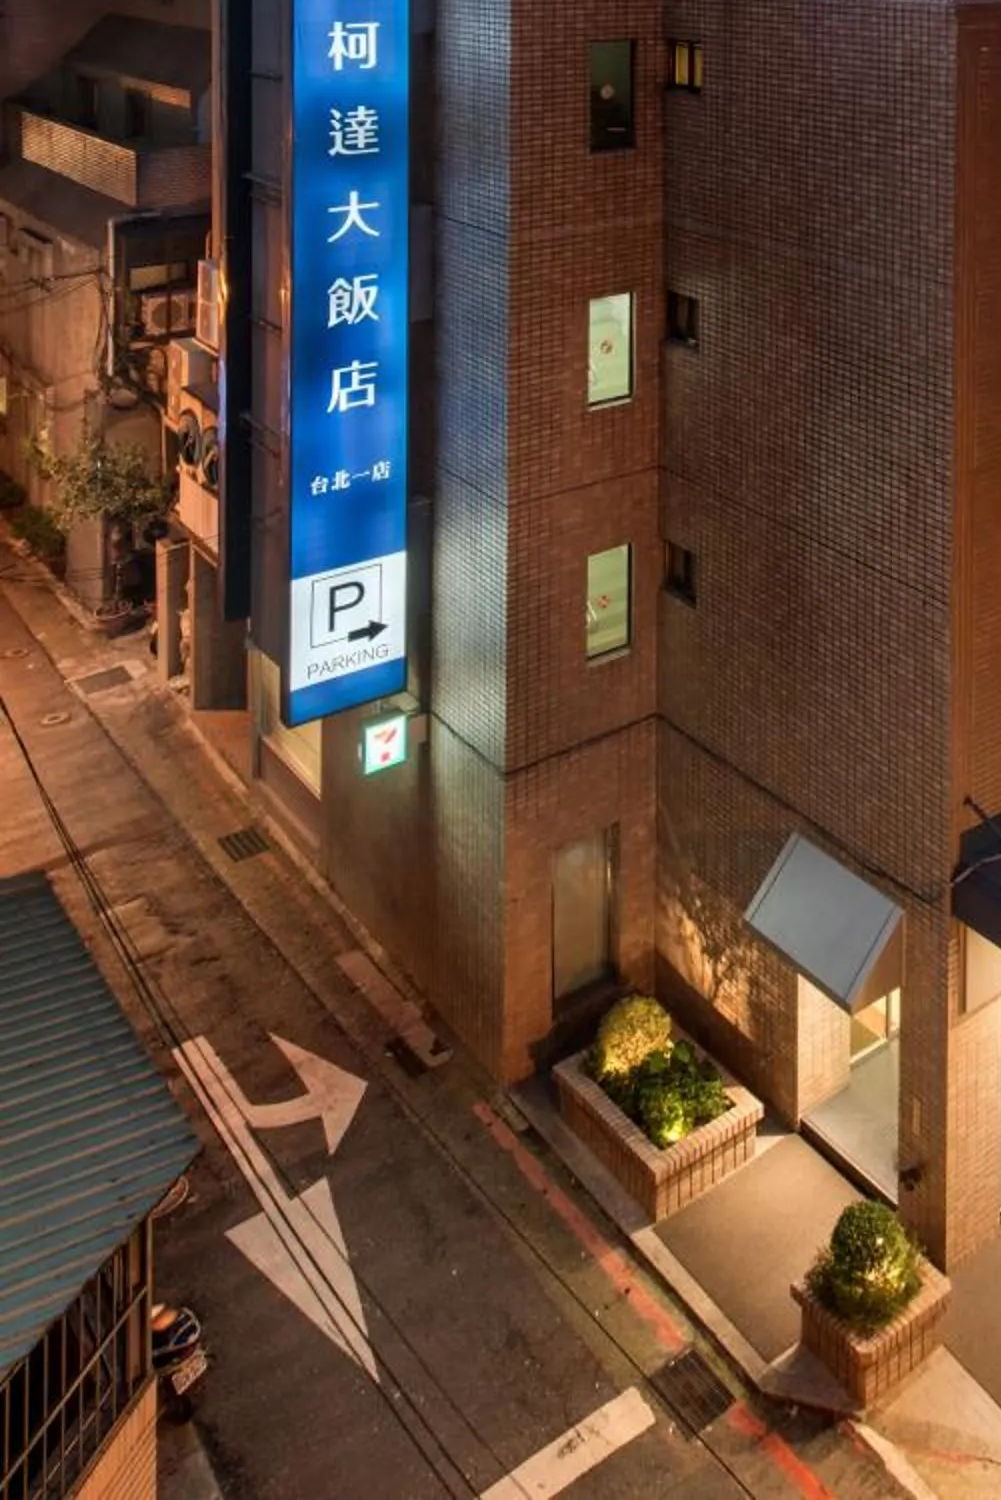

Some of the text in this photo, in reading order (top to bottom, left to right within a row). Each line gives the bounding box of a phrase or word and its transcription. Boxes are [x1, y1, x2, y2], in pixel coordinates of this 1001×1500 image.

[326, 21, 381, 414] 柯達大飯店
[311, 460, 391, 496] 台北一店
[328, 581, 365, 632] P
[306, 644, 390, 680] PARKING
